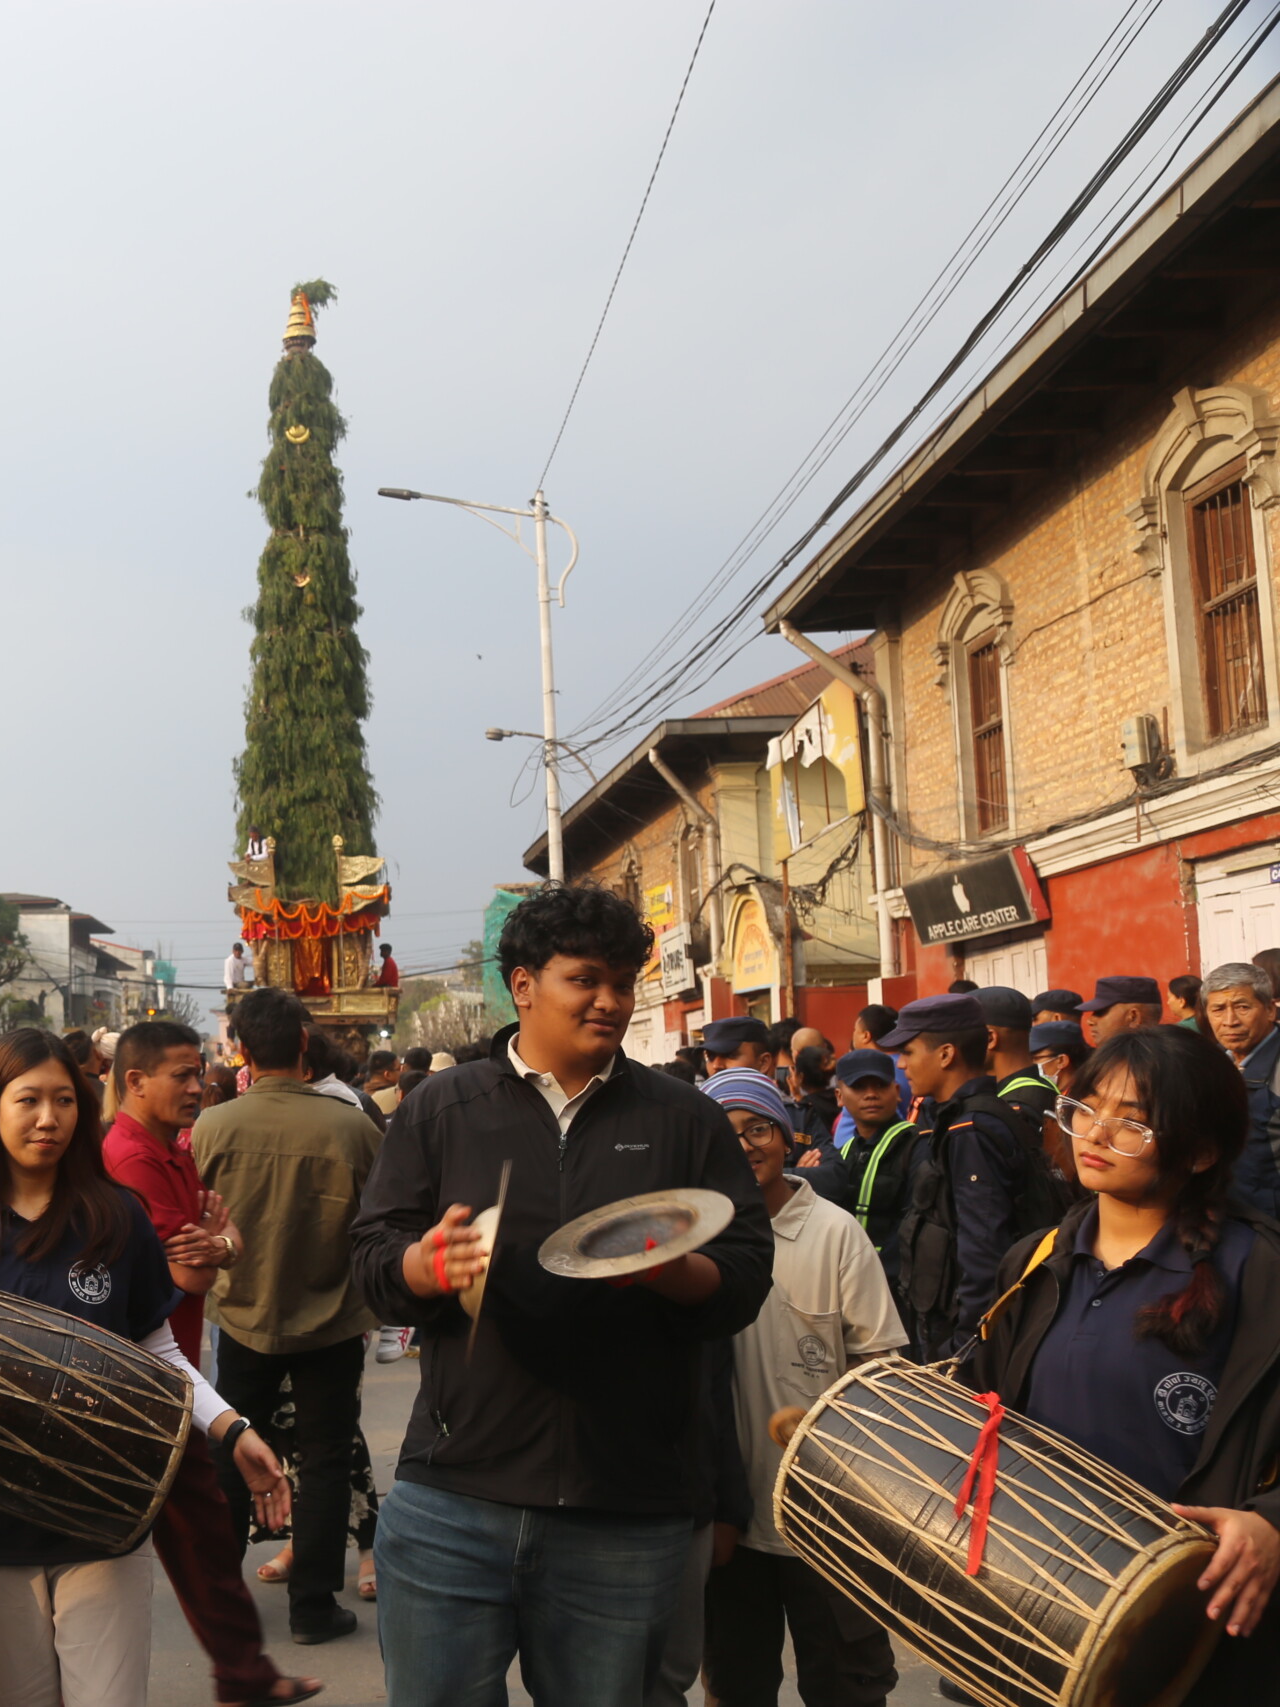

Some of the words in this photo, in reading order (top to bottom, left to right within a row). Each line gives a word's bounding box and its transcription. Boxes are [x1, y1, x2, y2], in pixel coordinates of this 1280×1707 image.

[927, 922, 956, 940] APPLE
[955, 914, 981, 934] CARE
[980, 905, 1019, 928] CENTER
